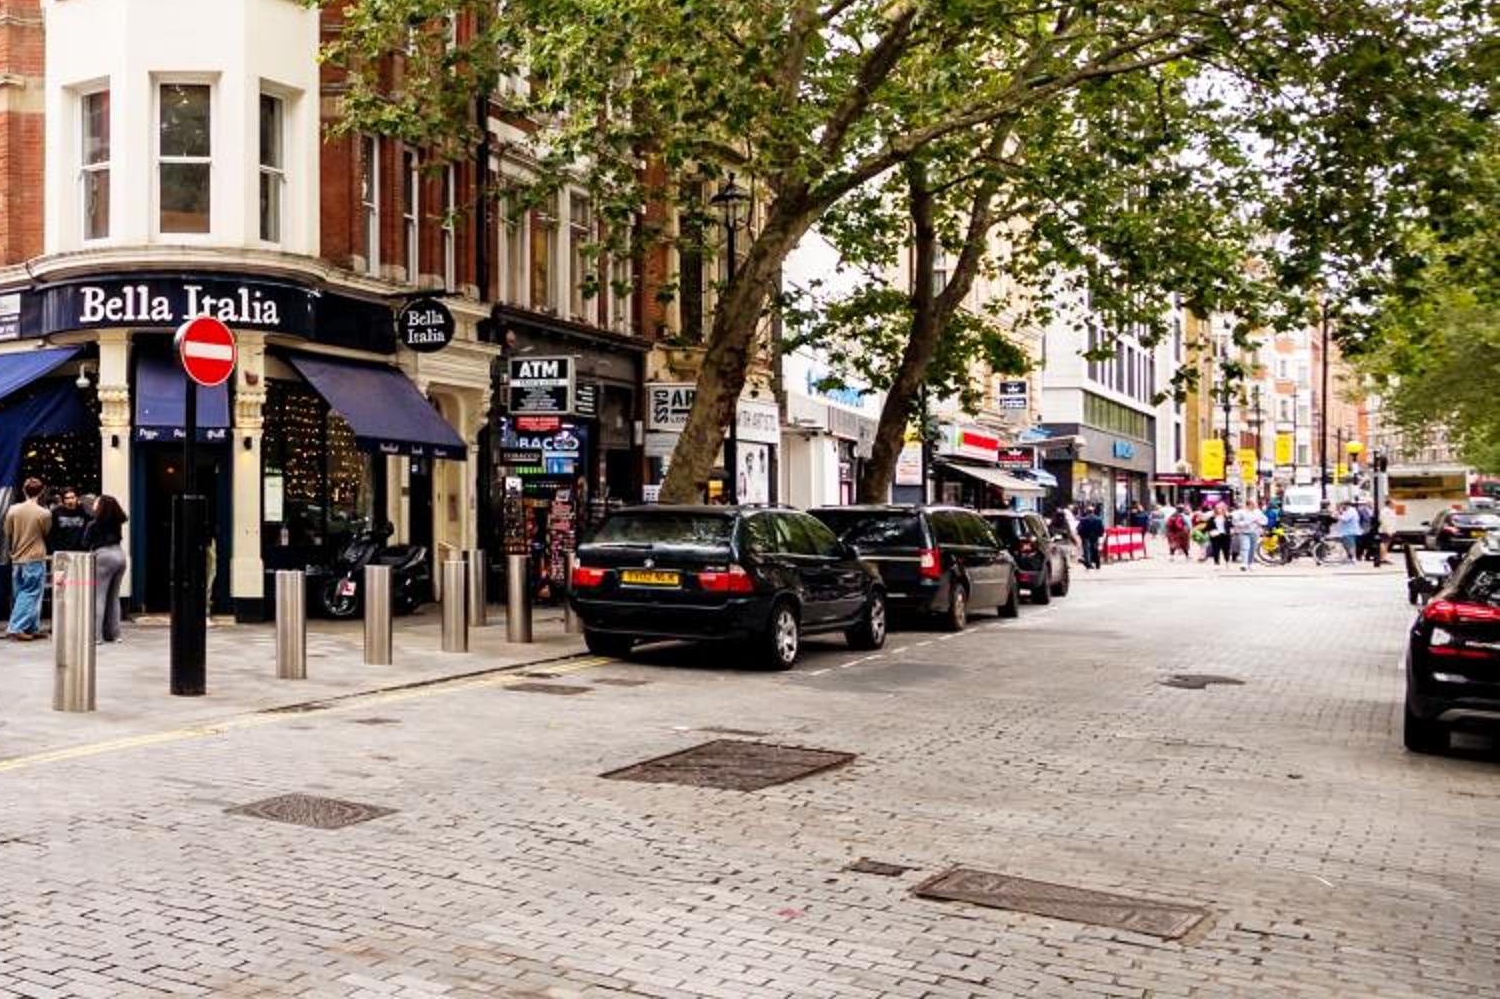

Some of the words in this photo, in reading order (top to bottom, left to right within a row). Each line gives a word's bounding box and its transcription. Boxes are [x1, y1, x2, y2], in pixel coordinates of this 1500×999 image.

[79, 284, 173, 323] Bella
[182, 285, 280, 325] Italia
[407, 310, 444, 326] Bella
[407, 328, 445, 344] Italia
[520, 361, 558, 378] ATM
[671, 389, 696, 407] AR
[654, 390, 668, 424] CASS
